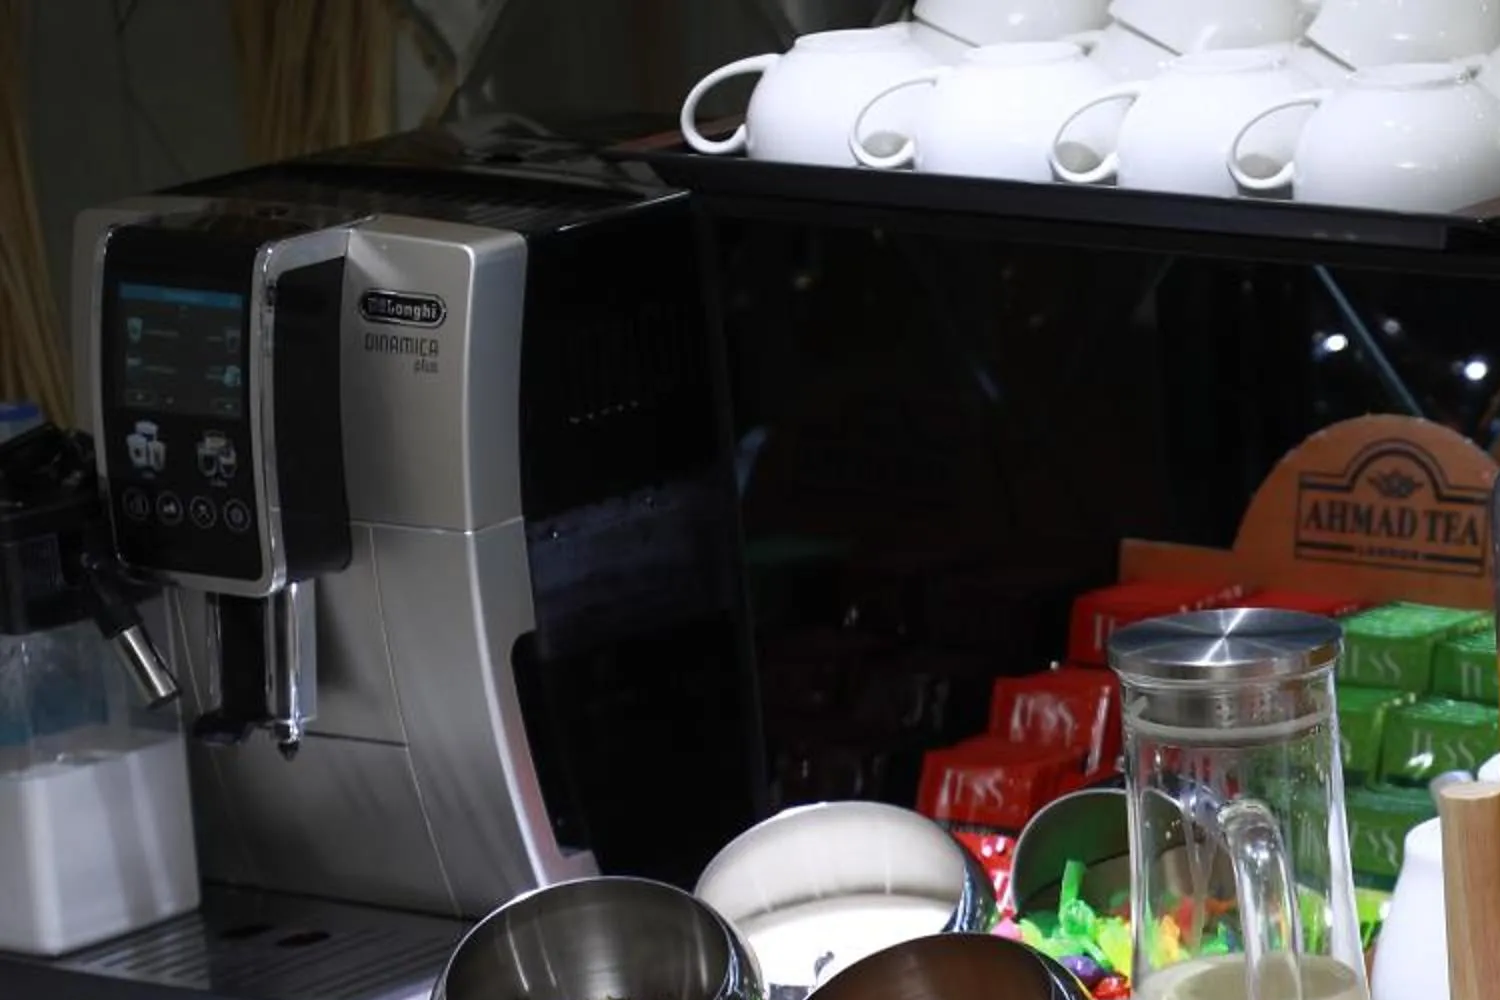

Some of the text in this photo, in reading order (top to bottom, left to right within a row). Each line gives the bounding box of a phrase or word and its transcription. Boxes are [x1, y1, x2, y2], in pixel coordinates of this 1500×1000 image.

[365, 333, 439, 357] DINAMICA
[1305, 501, 1479, 545] AHMAD TEA
